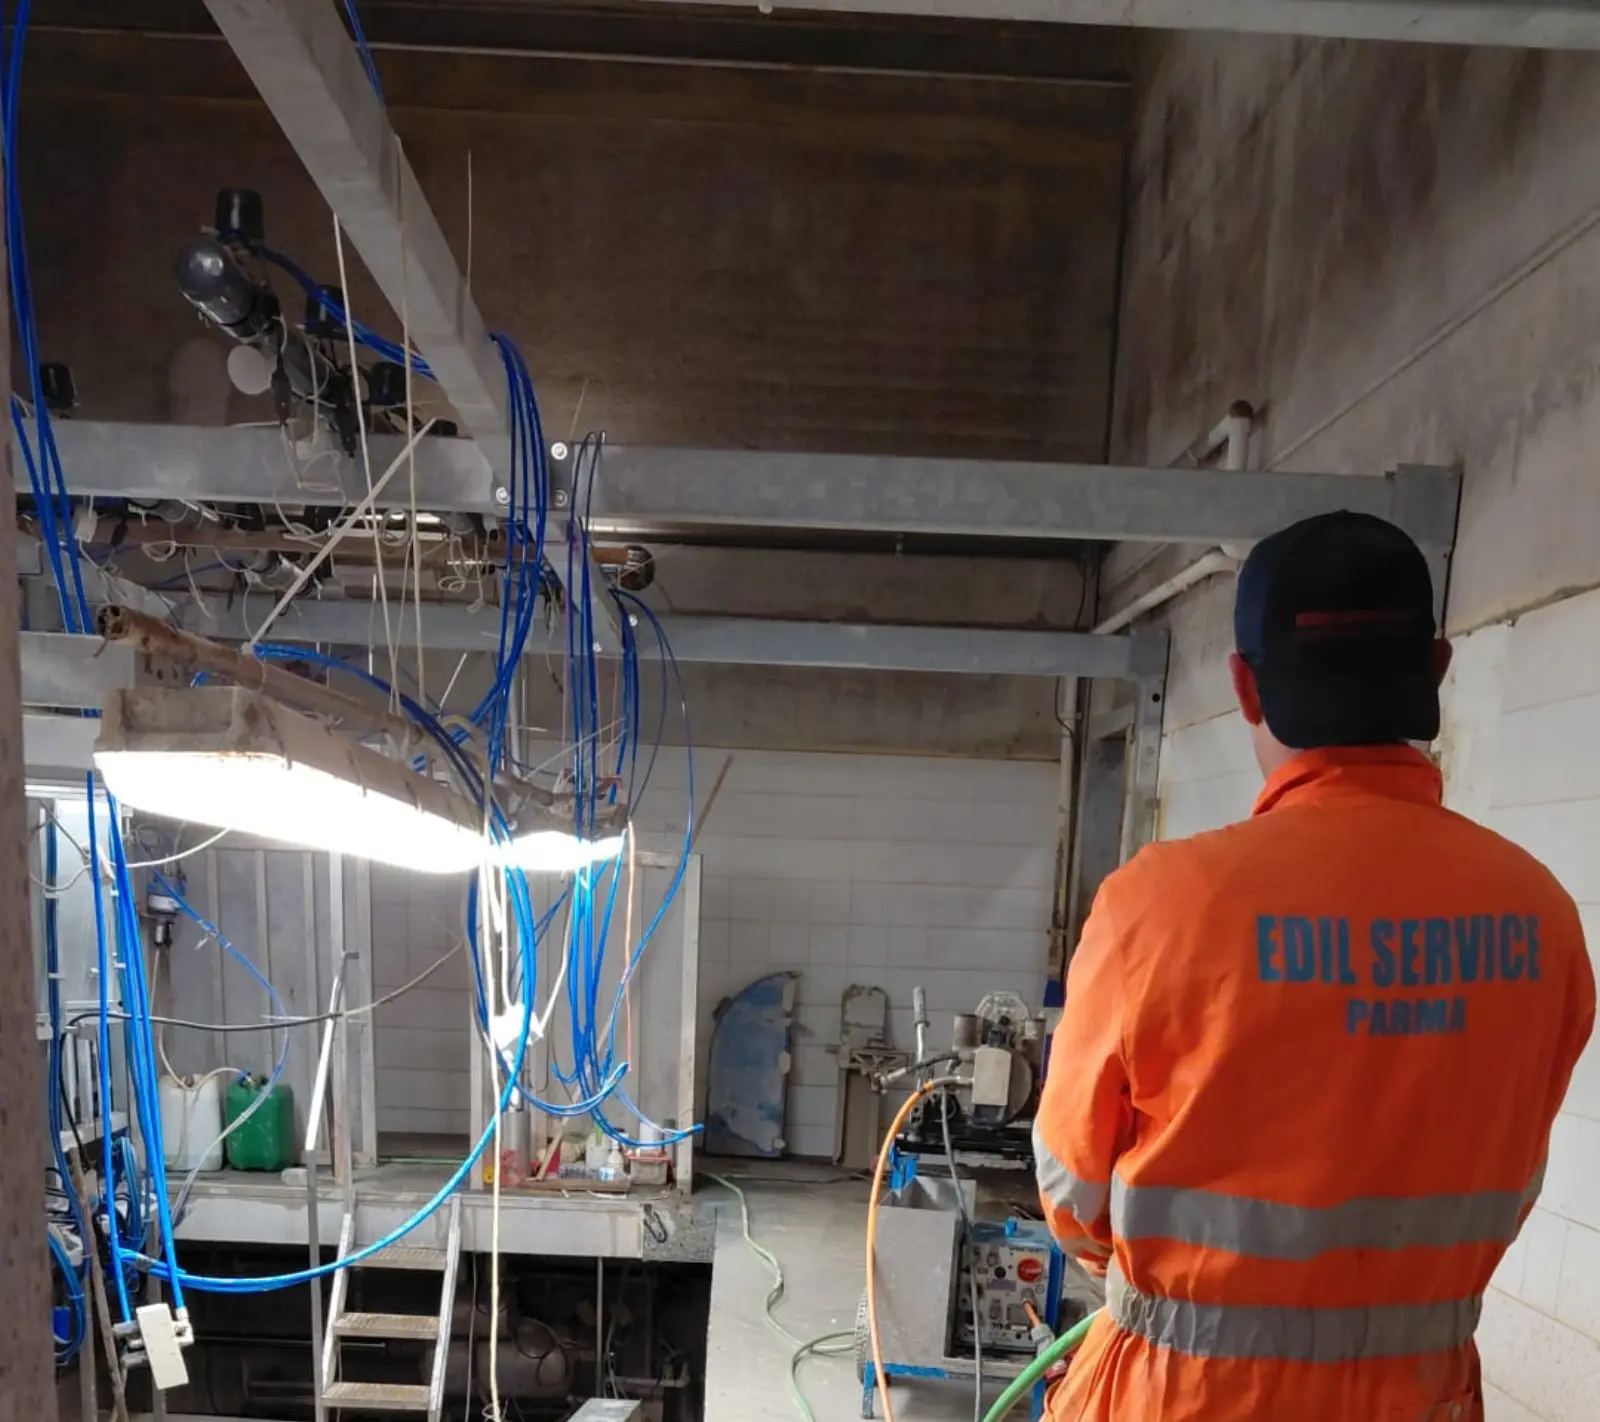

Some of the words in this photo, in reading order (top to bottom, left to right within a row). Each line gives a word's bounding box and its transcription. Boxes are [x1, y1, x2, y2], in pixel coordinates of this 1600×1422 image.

[1256, 915, 1357, 985] EDIL
[1370, 913, 1540, 987] SERVICE
[1346, 996, 1466, 1036] PARMA
